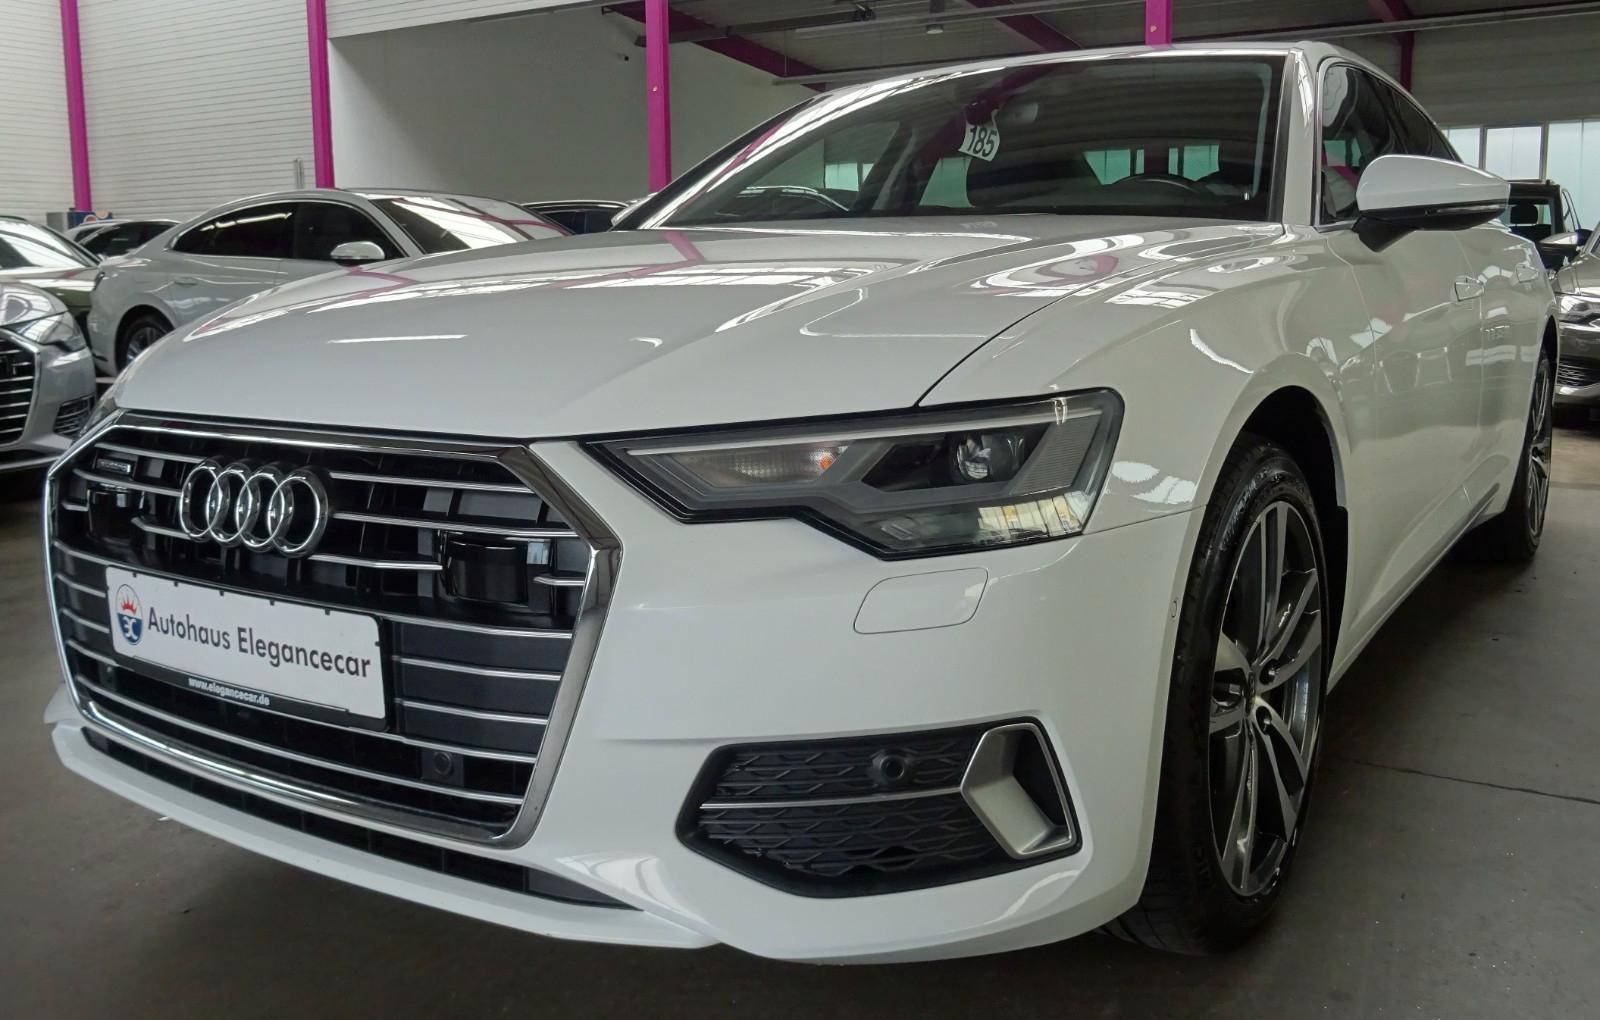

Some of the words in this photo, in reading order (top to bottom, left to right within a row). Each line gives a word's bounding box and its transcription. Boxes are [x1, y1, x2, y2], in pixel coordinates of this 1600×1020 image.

[967, 125, 997, 157] 185
[148, 607, 231, 650] Autohaus
[237, 626, 371, 678] Elegancecar
